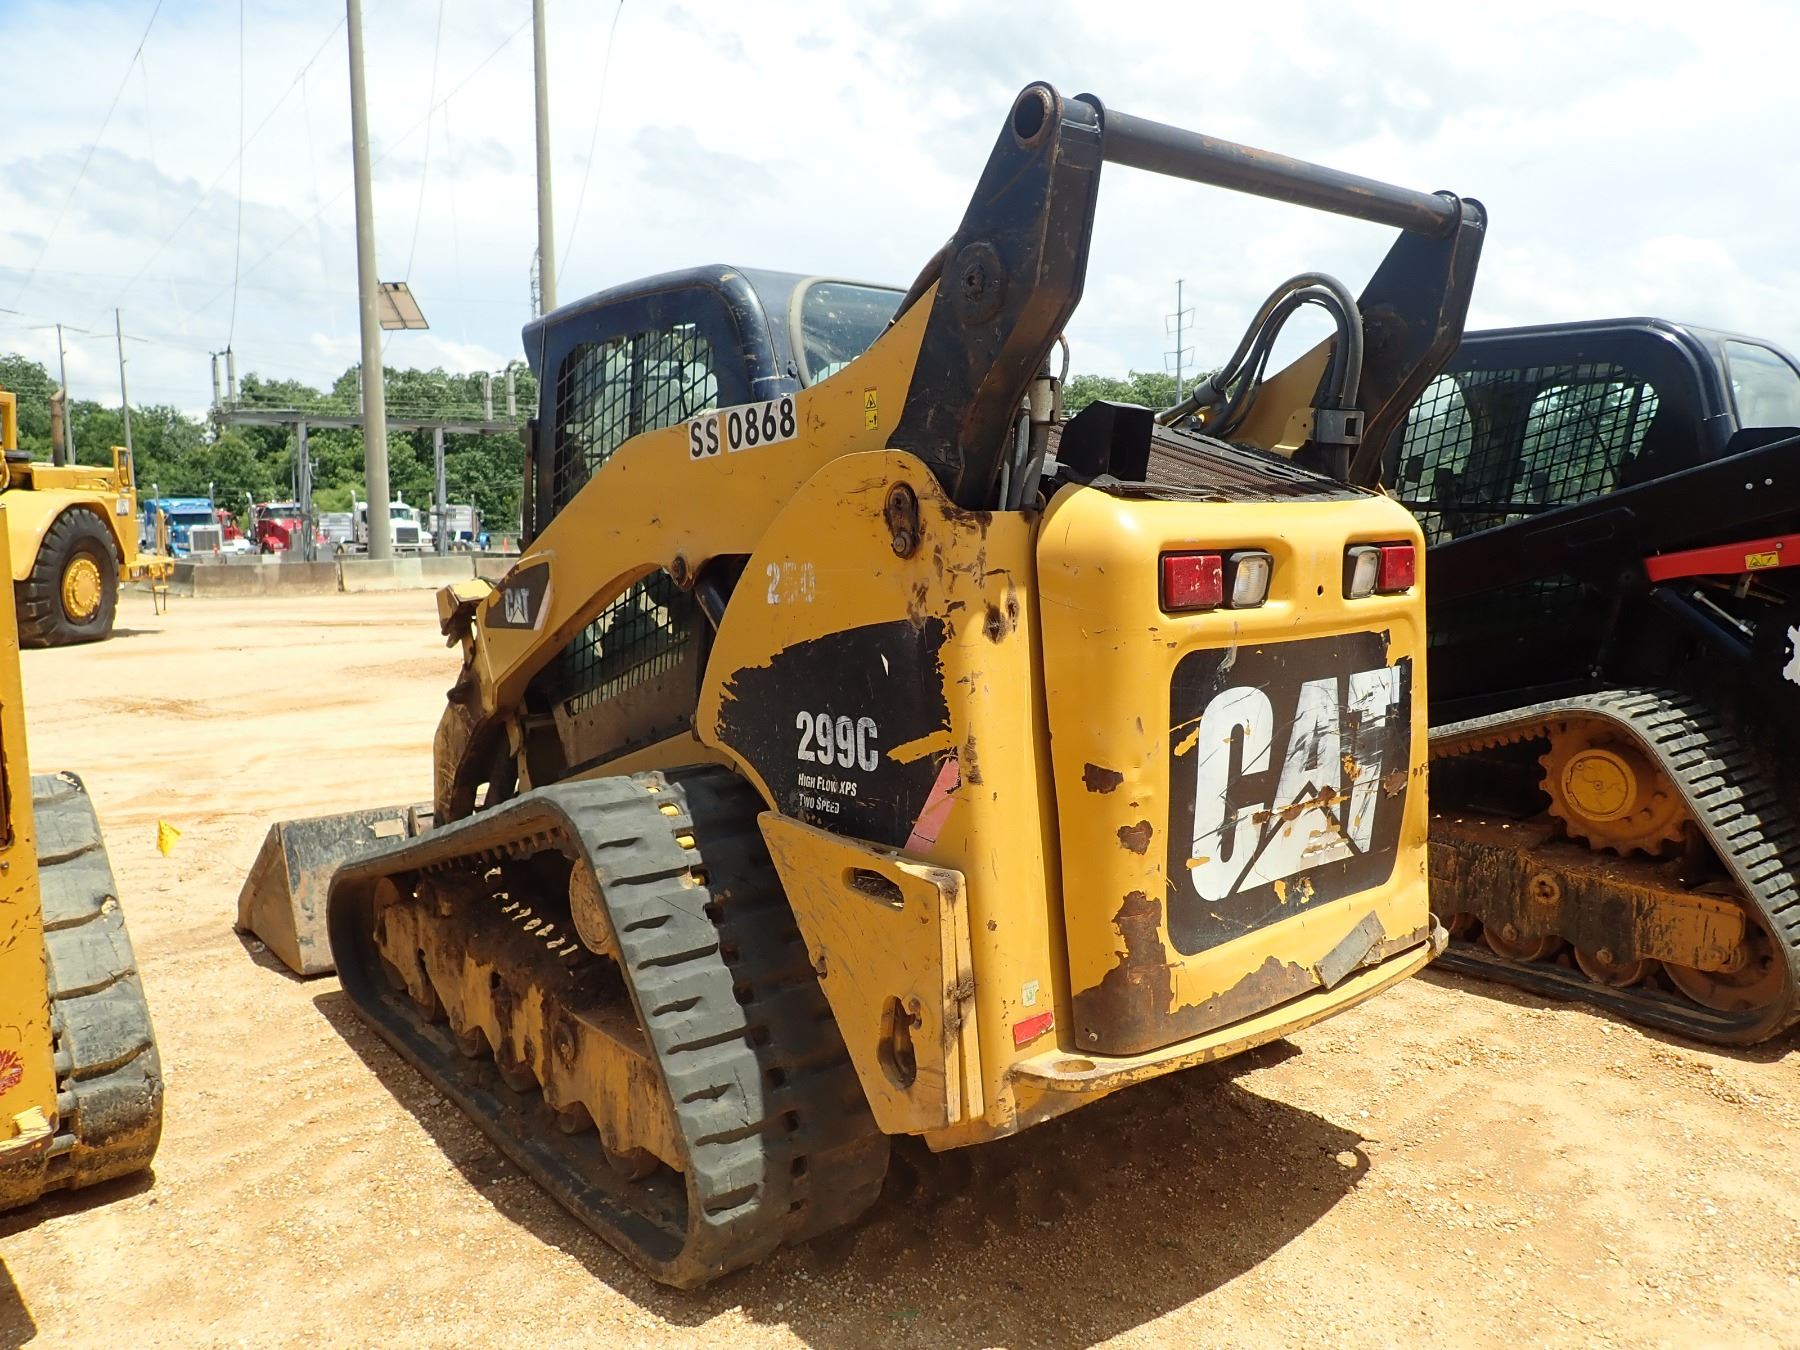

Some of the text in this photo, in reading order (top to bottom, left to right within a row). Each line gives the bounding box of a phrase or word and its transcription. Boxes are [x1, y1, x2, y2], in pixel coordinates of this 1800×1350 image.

[690, 397, 796, 458] SS 0868
[504, 587, 530, 624] CAT
[796, 710, 879, 772] 299C
[798, 773, 858, 797] HIGH FLOW XPS
[799, 793, 840, 814] TWO SPEED
[1191, 665, 1401, 901] CAT
